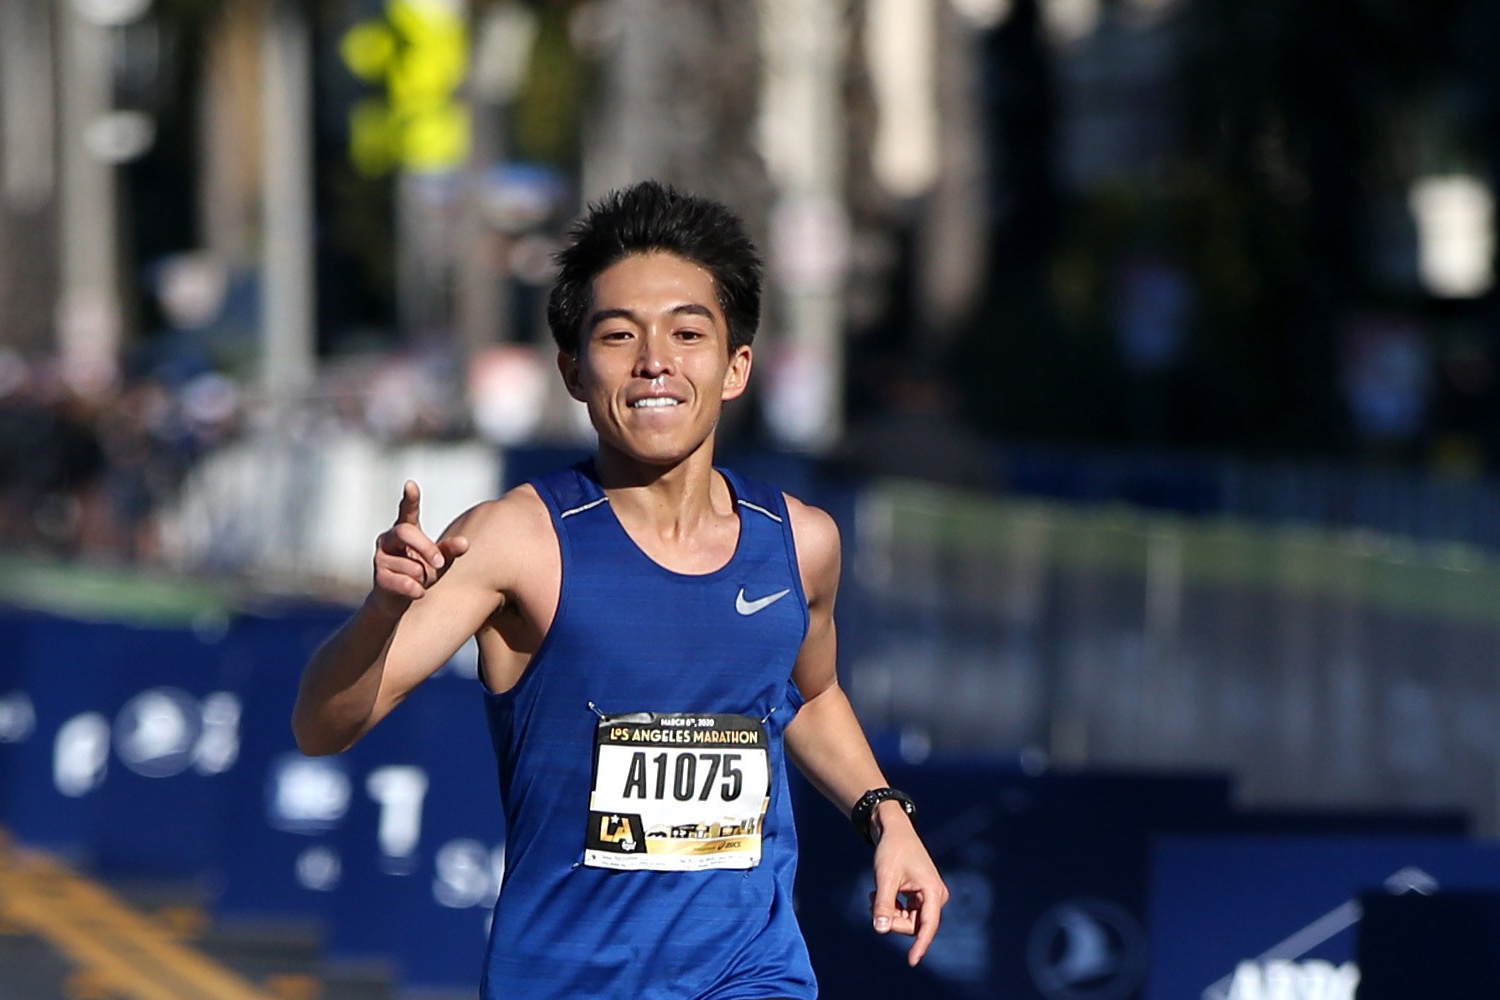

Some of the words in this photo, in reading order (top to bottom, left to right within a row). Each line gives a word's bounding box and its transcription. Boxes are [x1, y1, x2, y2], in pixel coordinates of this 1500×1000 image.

[610, 728, 629, 742] LOS
[631, 729, 691, 743] ANGELES
[693, 730, 758, 744] MARATHON
[622, 751, 743, 802] A1075
[600, 815, 634, 845] LA
